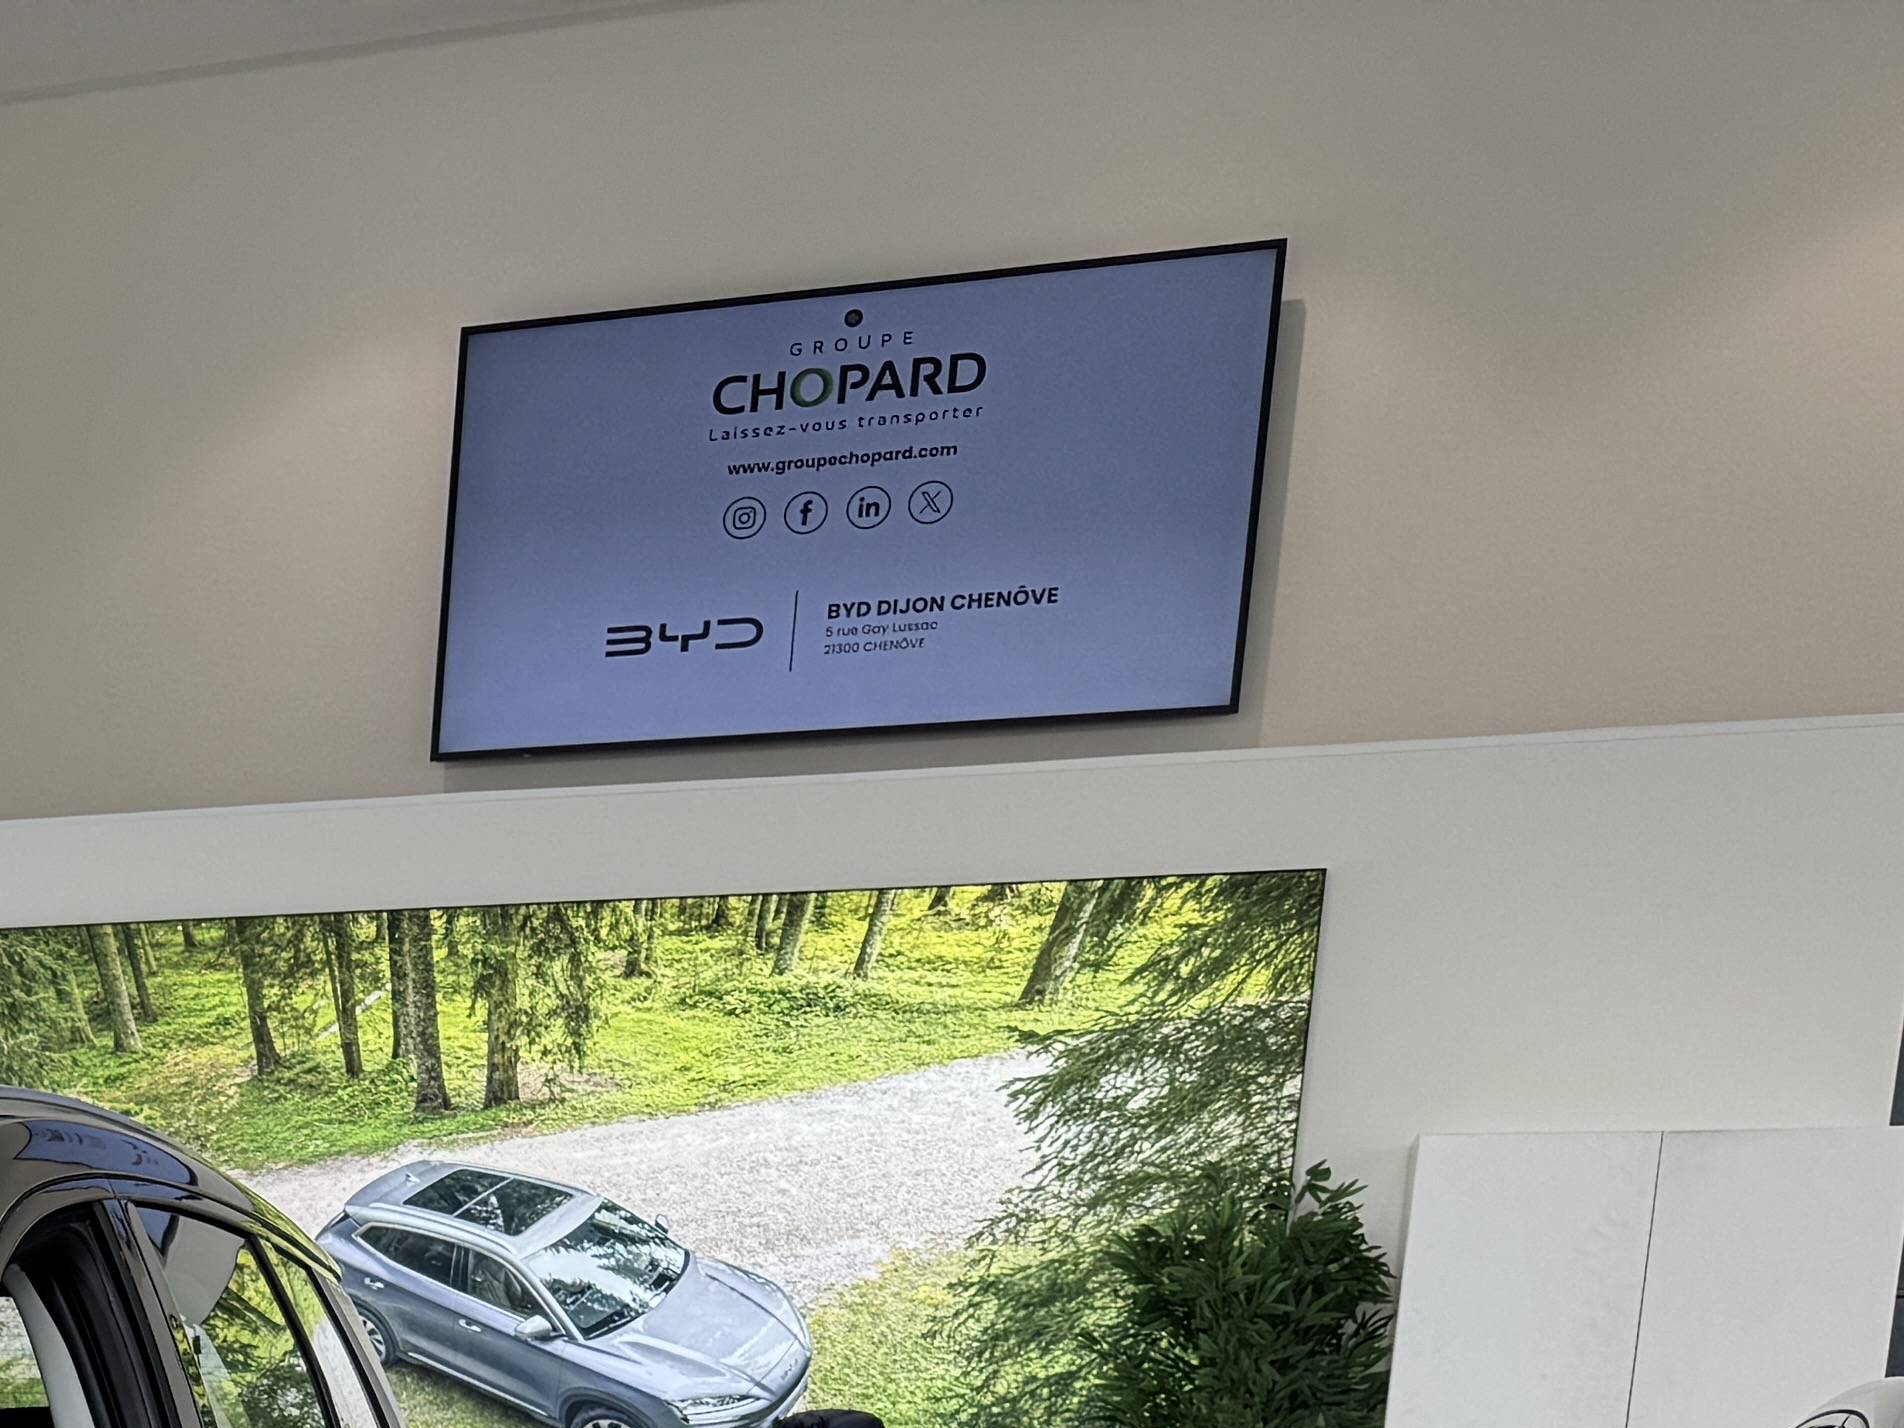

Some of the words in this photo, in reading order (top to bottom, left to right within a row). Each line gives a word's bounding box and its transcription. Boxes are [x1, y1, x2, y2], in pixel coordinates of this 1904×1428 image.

[790, 331, 914, 356] GROUPE
[712, 352, 987, 415] CHOPARD
[708, 418, 848, 442] Laissez-vous
[857, 405, 984, 429] transporter
[726, 443, 959, 476] www.groupechopard.com
[826, 599, 872, 620] BYD
[876, 595, 946, 617] DIJON
[950, 585, 1060, 612] CHENÔVE
[604, 616, 765, 658] BYD
[837, 626, 859, 637] rue
[863, 637, 926, 653] CHENÔVE
